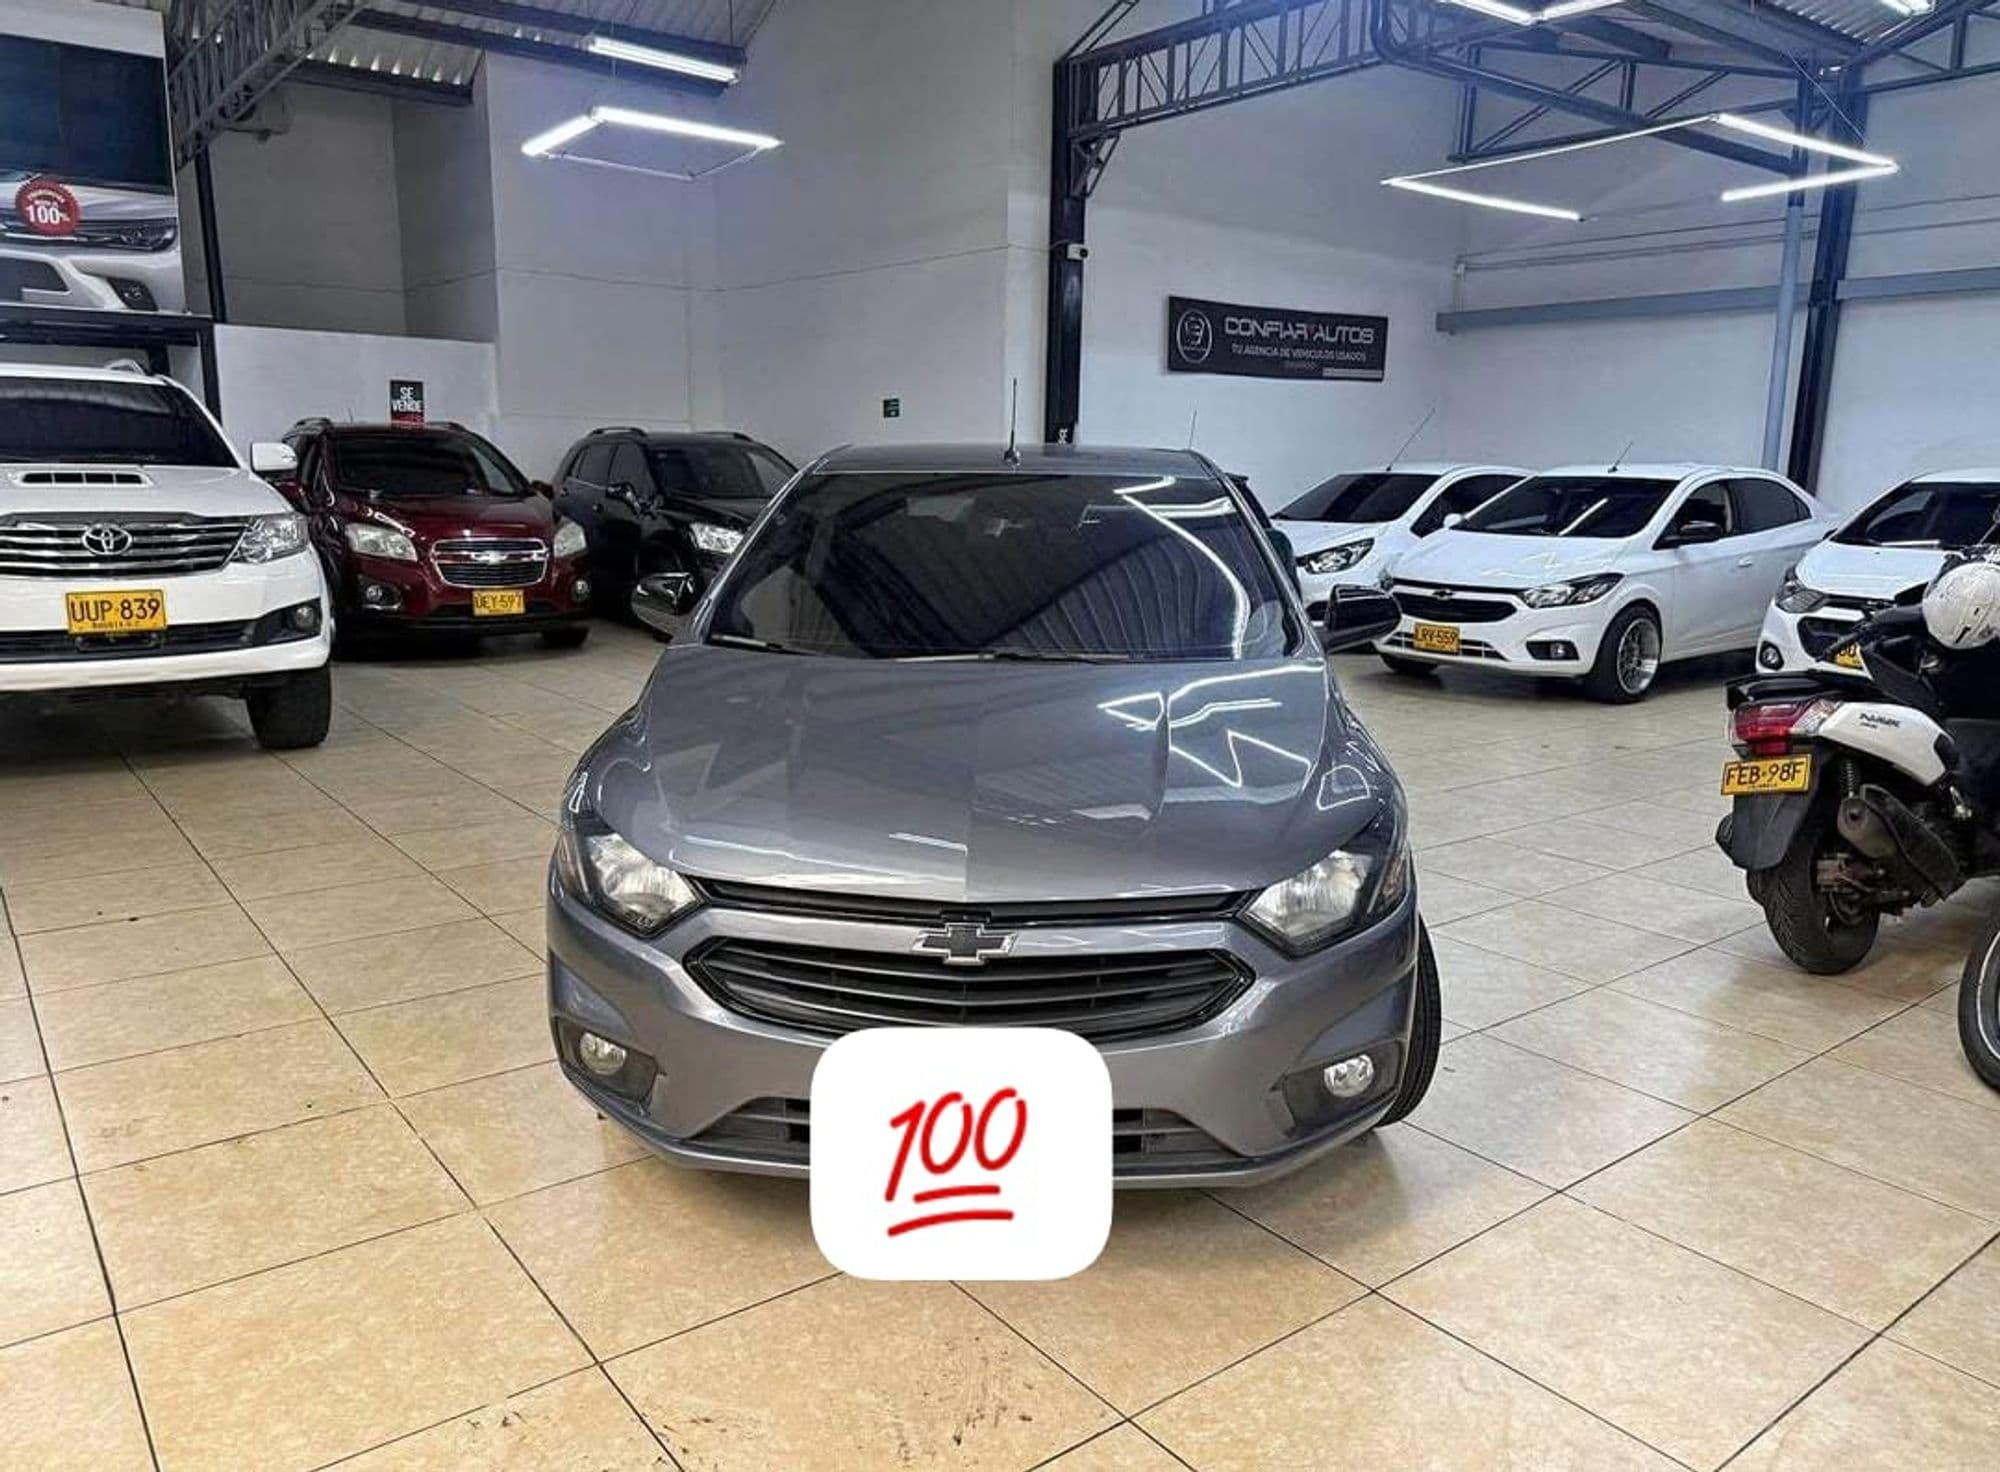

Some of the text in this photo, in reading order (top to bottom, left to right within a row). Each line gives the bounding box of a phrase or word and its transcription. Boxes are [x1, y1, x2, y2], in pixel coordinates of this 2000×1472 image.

[1225, 317, 1374, 344] CONFIAR AUTOS
[400, 386, 415, 400] SE
